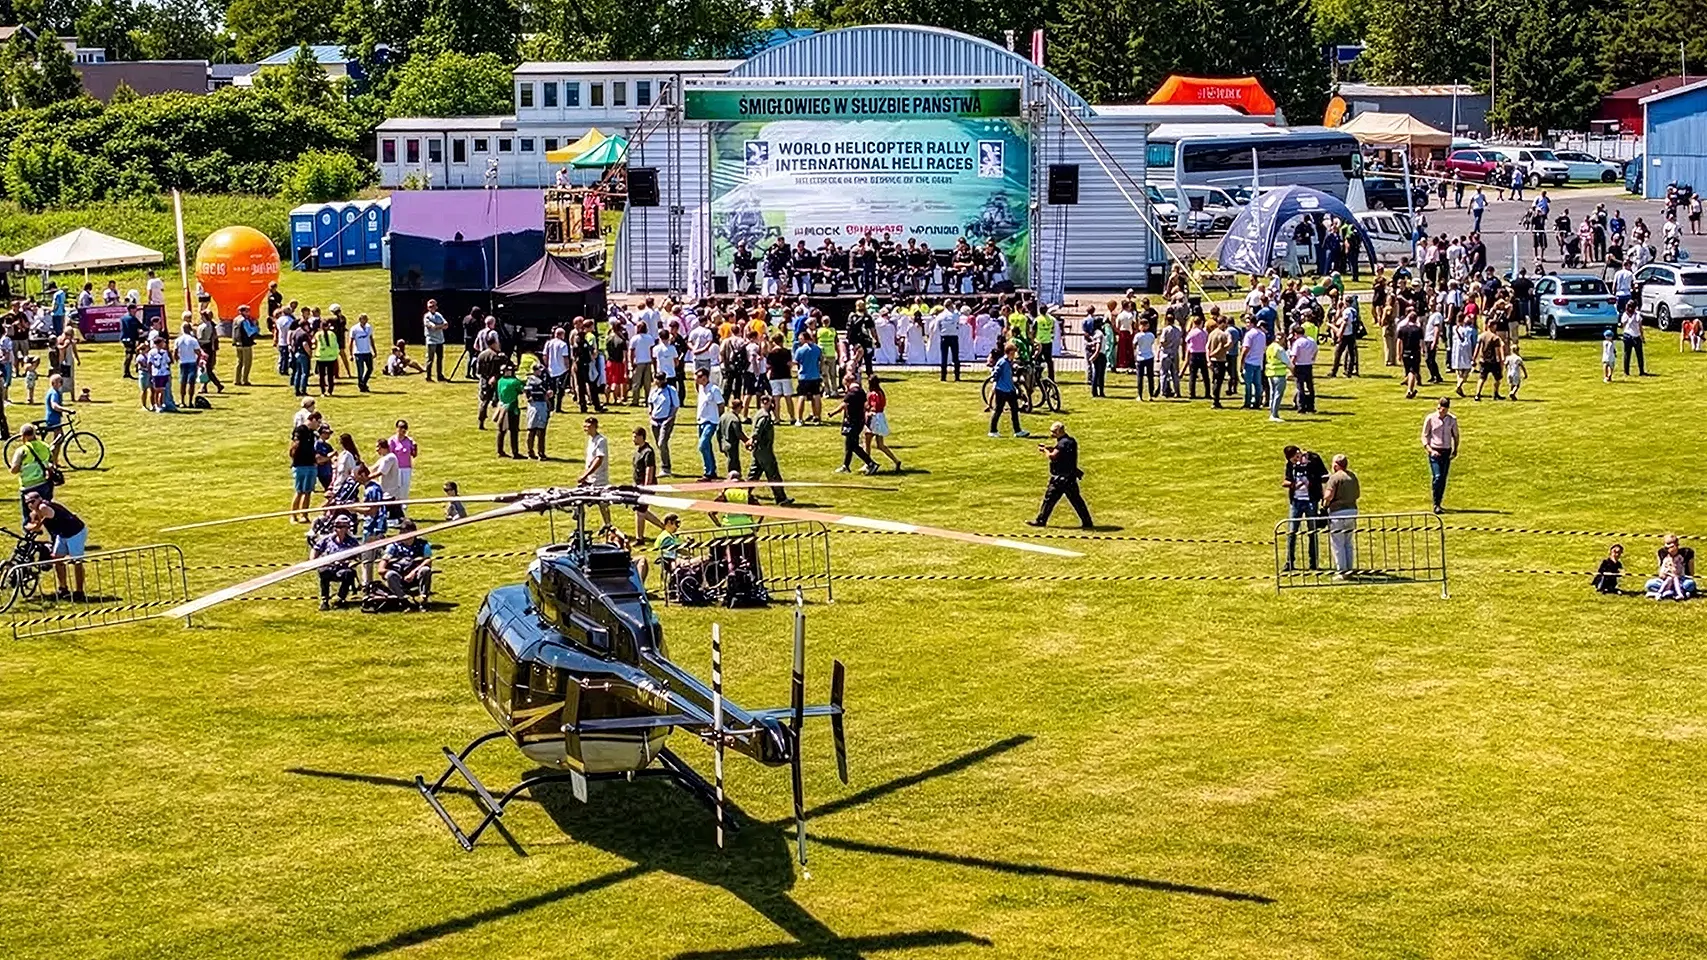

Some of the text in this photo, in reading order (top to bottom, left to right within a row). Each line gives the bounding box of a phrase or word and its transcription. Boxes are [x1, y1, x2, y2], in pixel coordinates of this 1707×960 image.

[739, 93, 982, 115] ŚMIGŁOWIEC W SŁUŻBIE PAŃSTWA
[778, 141, 970, 155] WORLD HELICOPTER RALLY
[775, 157, 974, 172] INTERNATIONAL HELI RACES
